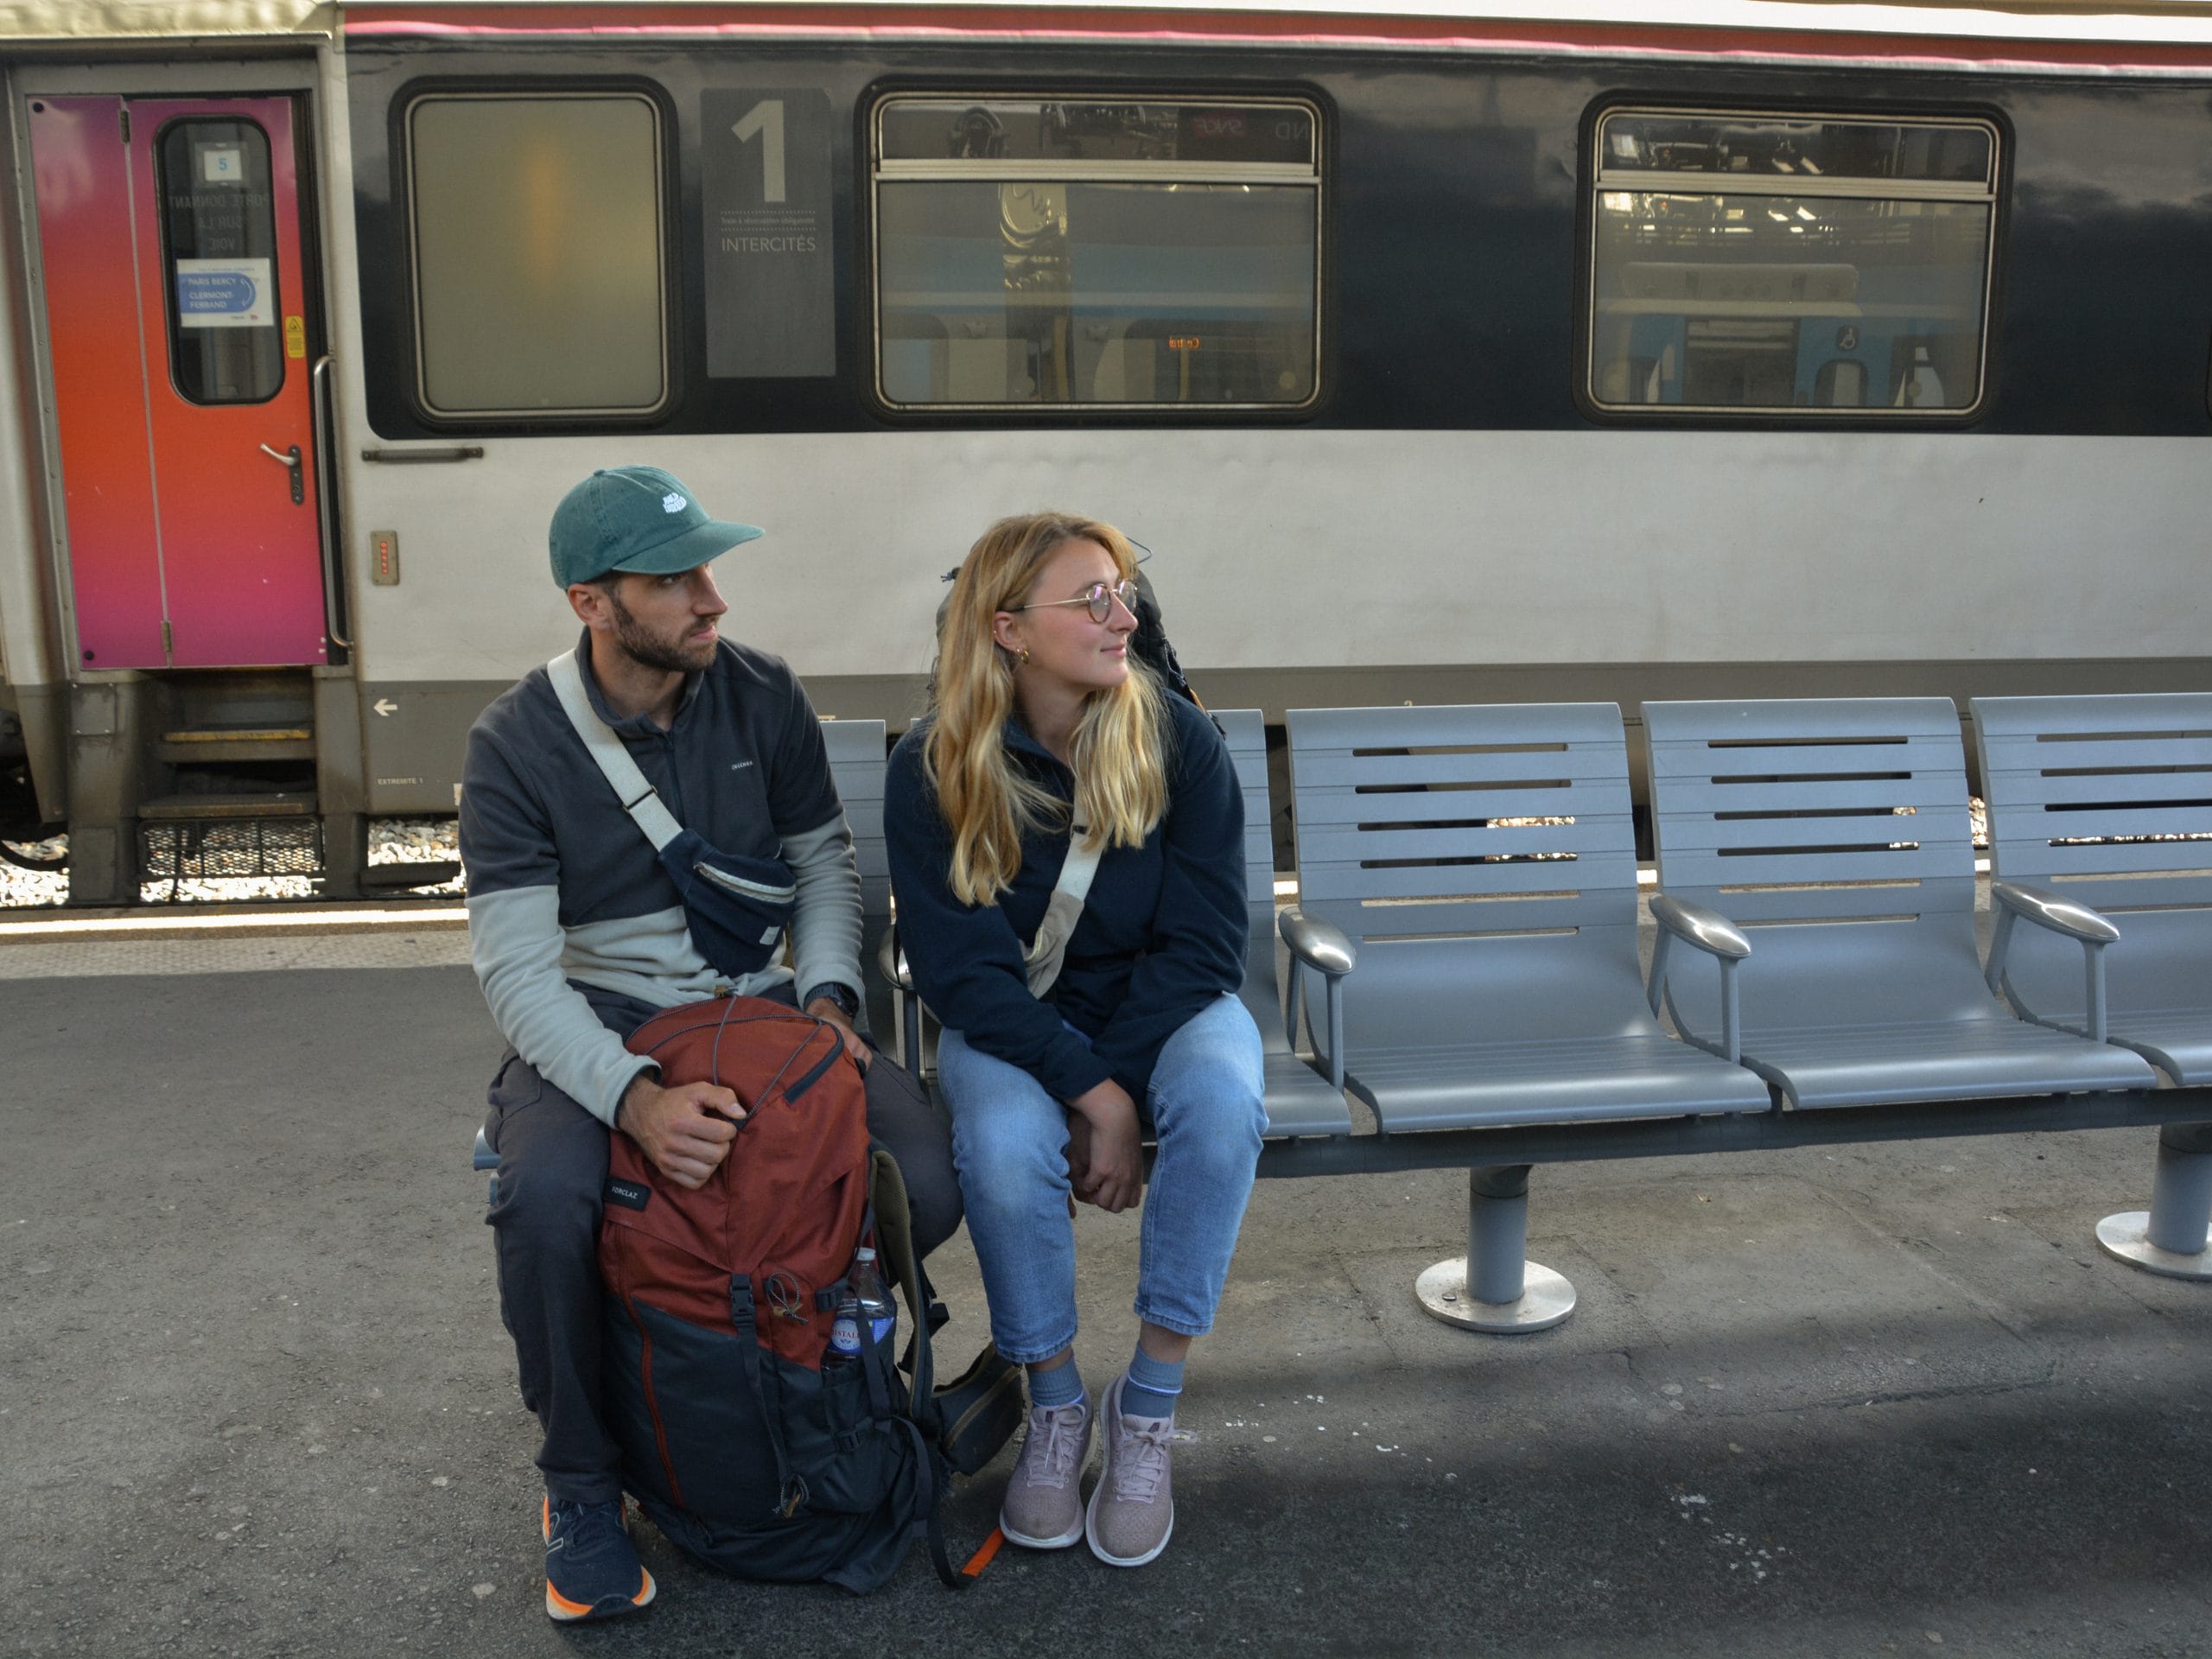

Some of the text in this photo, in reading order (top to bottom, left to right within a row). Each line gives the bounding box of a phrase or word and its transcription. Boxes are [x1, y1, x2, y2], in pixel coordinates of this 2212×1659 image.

[731, 99, 785, 202] 1
[218, 157, 228, 171] 5
[721, 234, 816, 252] INTERCITÉS
[188, 277, 209, 286] PARIS
[189, 301, 227, 309] FERRAND
[612, 1185, 639, 1200] FORCLAZ
